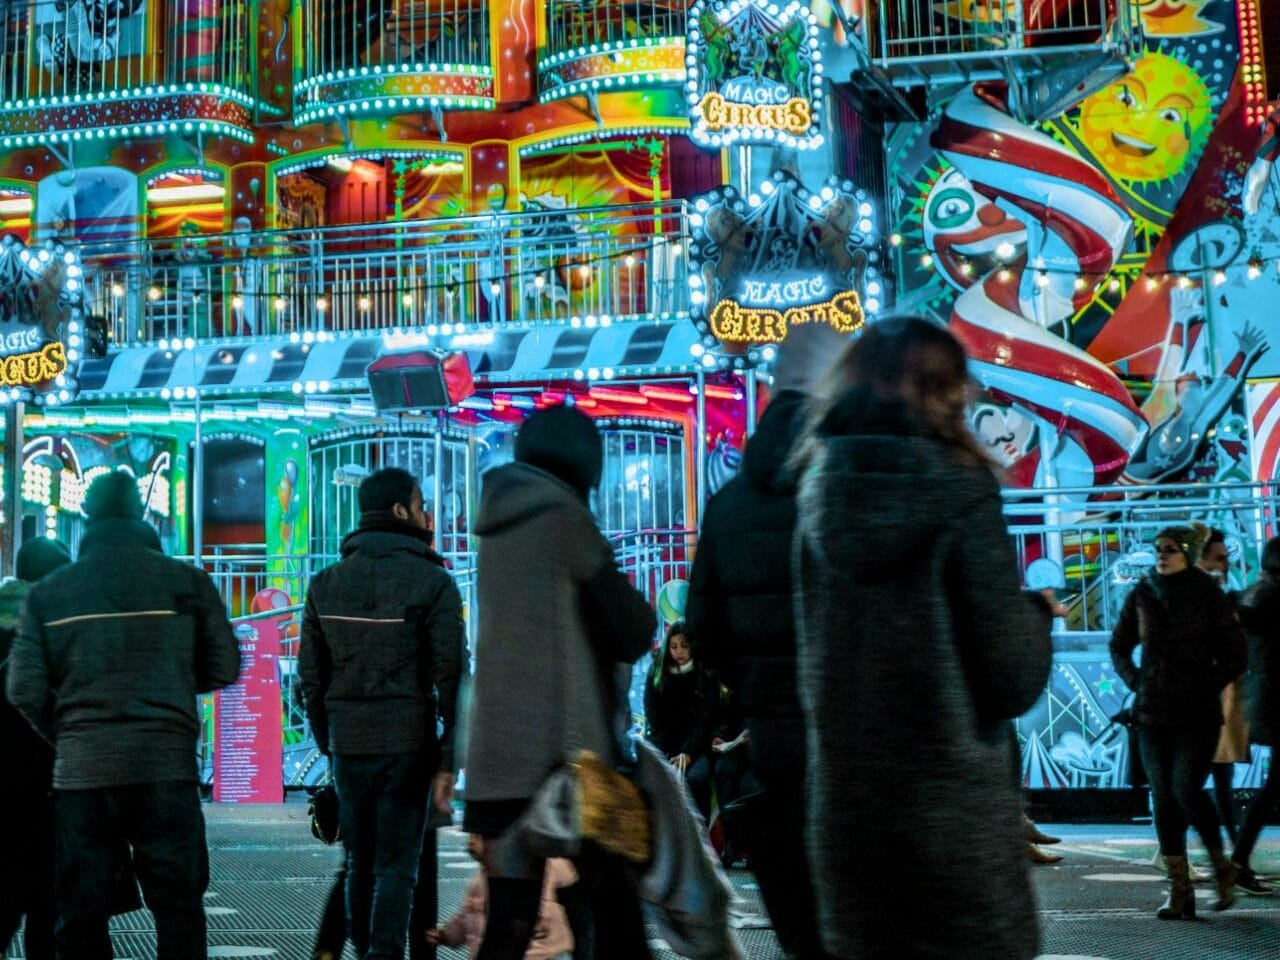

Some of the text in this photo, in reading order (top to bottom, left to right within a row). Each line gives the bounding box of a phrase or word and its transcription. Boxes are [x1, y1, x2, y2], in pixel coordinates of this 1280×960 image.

[724, 83, 791, 104] MAGIC
[701, 92, 811, 132] CIRCUS
[740, 275, 827, 304] MAGIC
